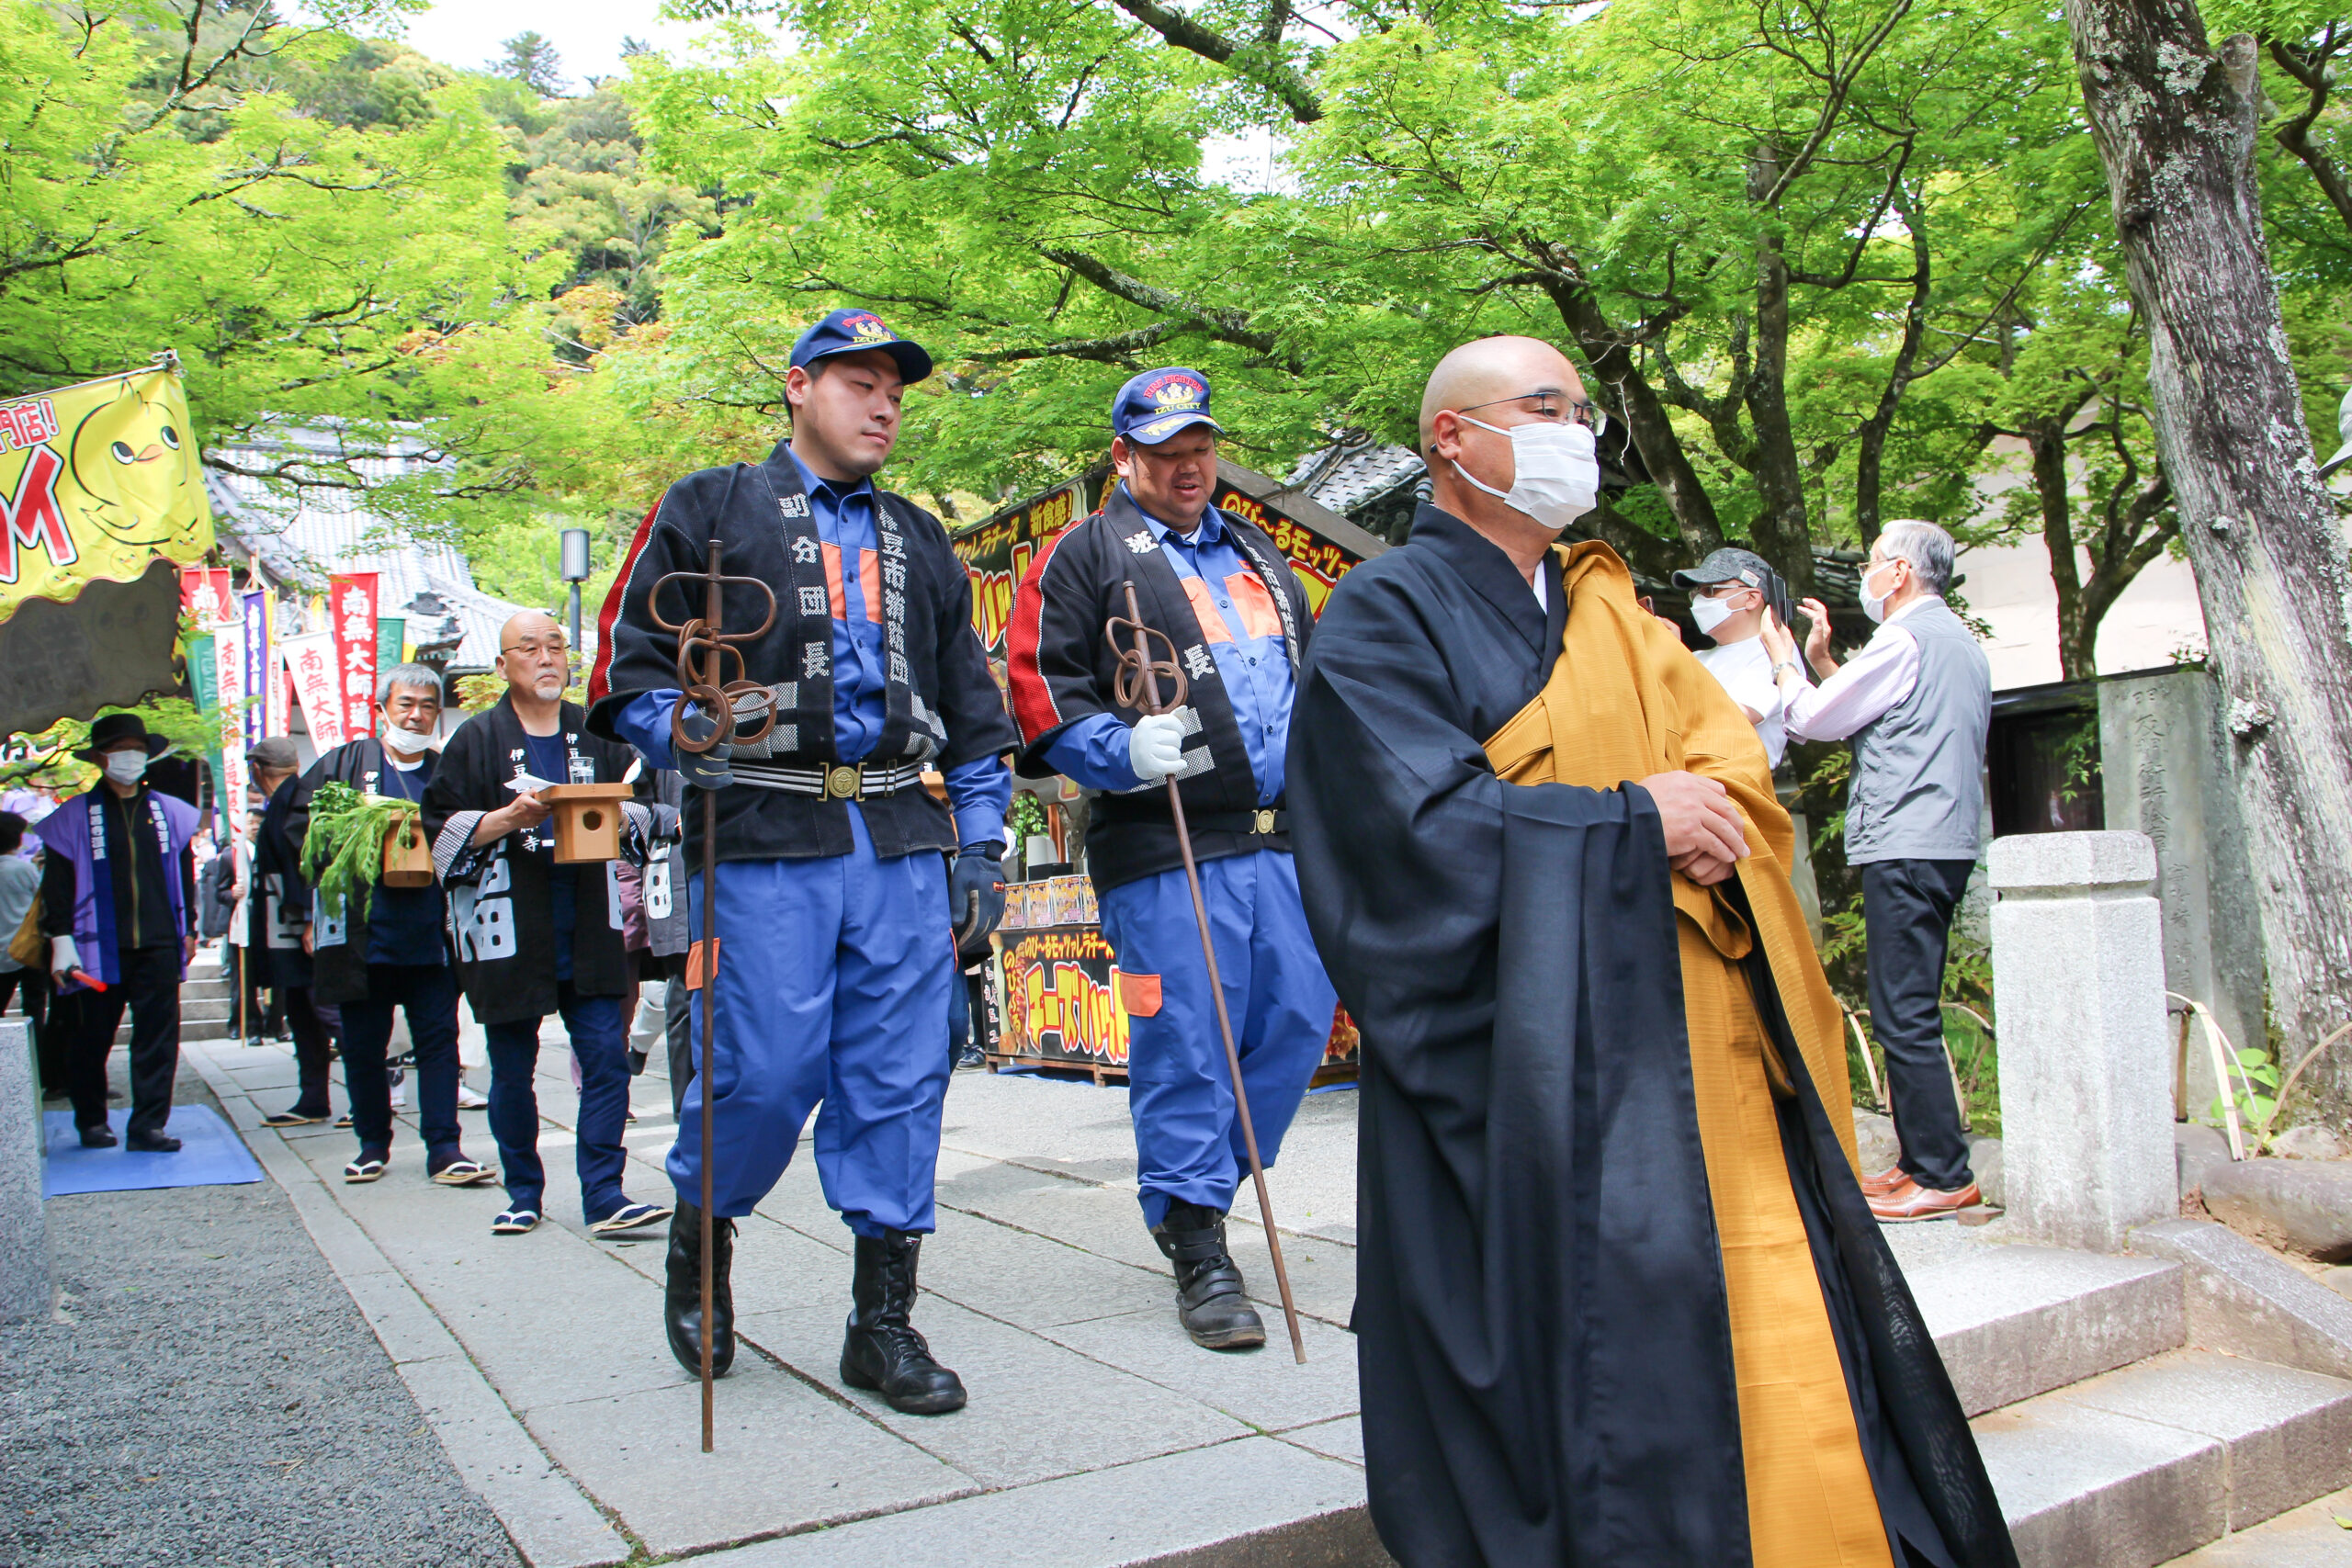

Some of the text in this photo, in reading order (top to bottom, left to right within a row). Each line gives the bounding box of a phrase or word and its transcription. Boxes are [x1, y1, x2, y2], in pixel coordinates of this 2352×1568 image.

[1143, 374, 1204, 399] FIRE FIGHTER
[1154, 402, 1201, 415] IZU CITY
[1029, 489, 1075, 538] 新食感!
